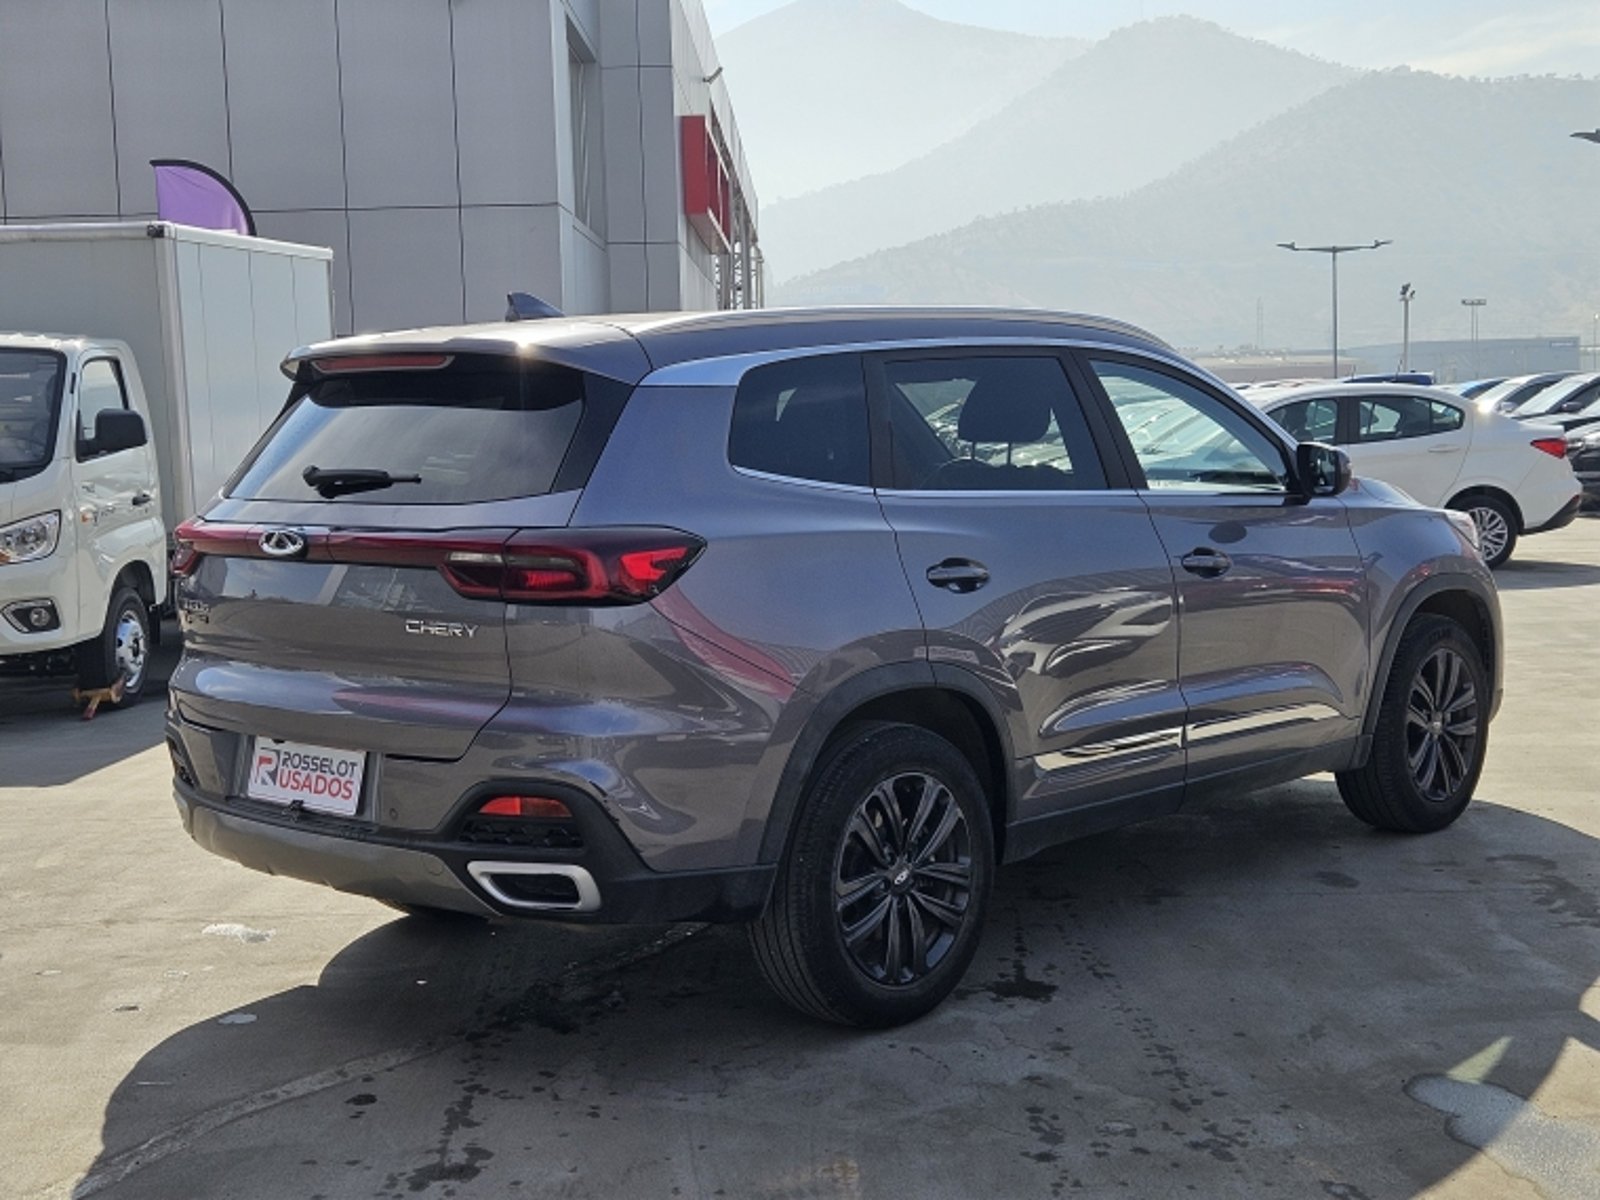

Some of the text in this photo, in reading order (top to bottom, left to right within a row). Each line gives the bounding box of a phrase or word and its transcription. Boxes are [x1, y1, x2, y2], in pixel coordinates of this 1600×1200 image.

[405, 619, 479, 638] CHERY
[281, 751, 358, 778] ROSSELOT
[279, 769, 354, 800] USADOS
